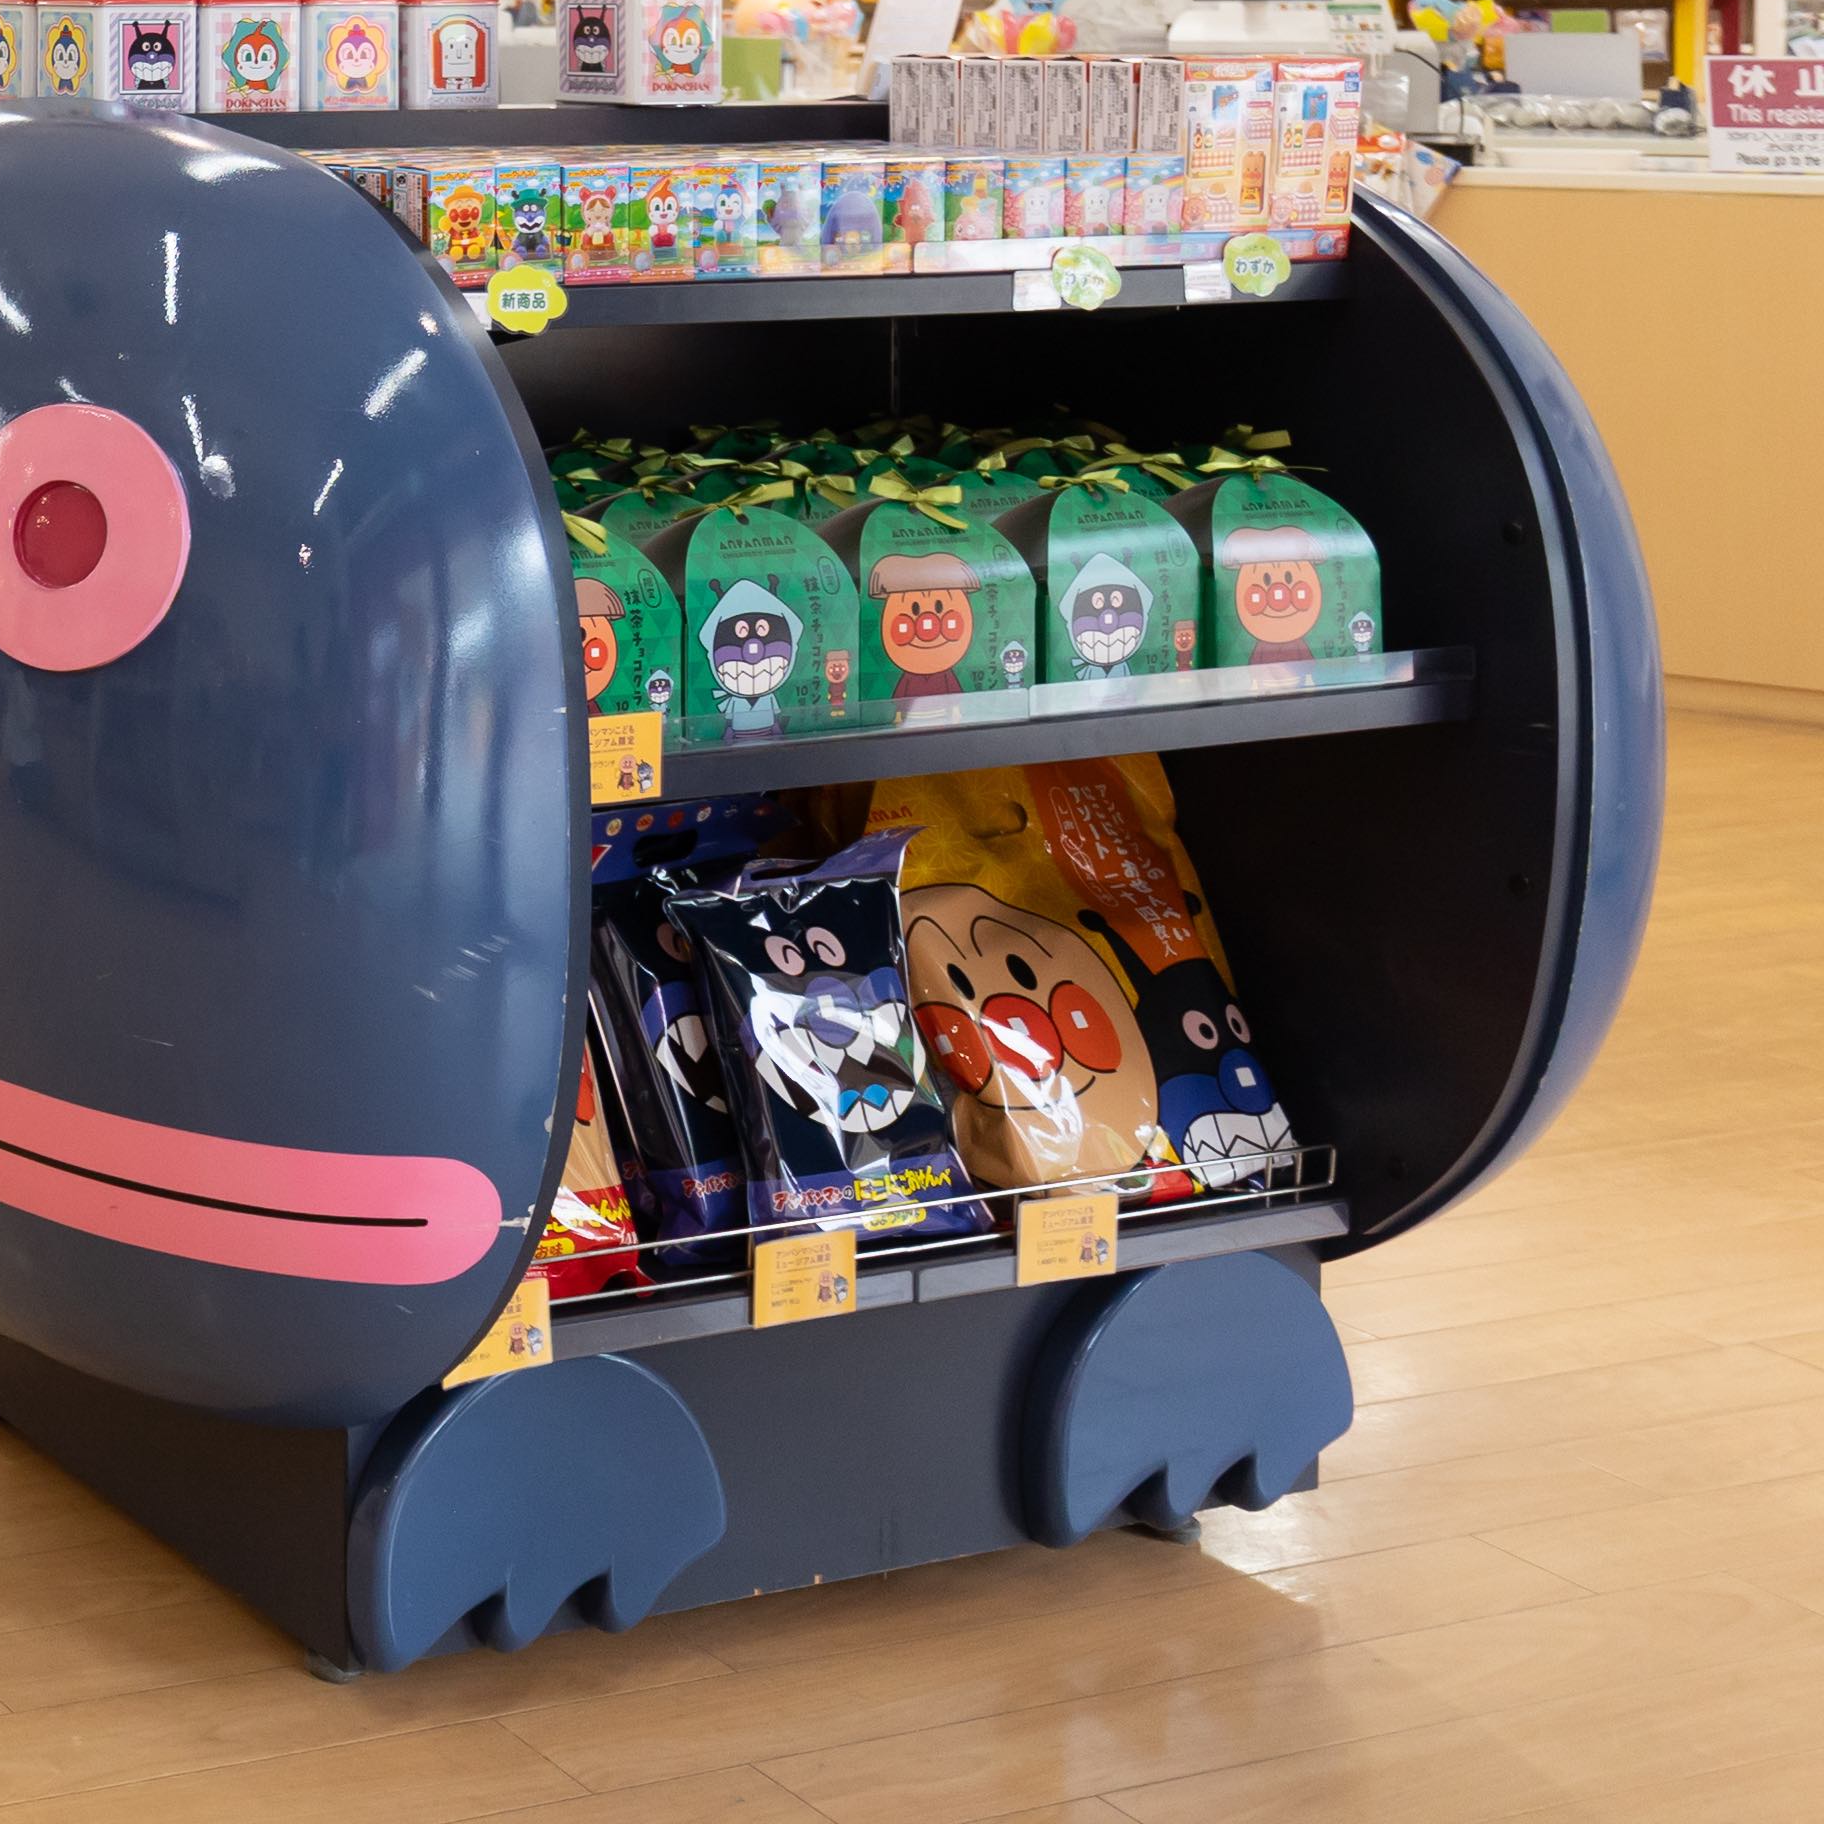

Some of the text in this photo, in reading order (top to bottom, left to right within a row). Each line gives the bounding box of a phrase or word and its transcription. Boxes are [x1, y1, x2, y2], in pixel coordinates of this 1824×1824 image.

[225, 97, 288, 108] DOKINCHAN
[1235, 257, 1275, 274] わずか
[501, 292, 547, 310] 新商品
[1242, 499, 1313, 512] ANPANMAN
[1077, 510, 1145, 525] ANPANMAN
[892, 527, 966, 540] ANPANM
[719, 536, 795, 551] ANPANMAN
[1155, 550, 1171, 674] 抹茶チョコクラン
[623, 589, 643, 707] 抹茶チョコクラ
